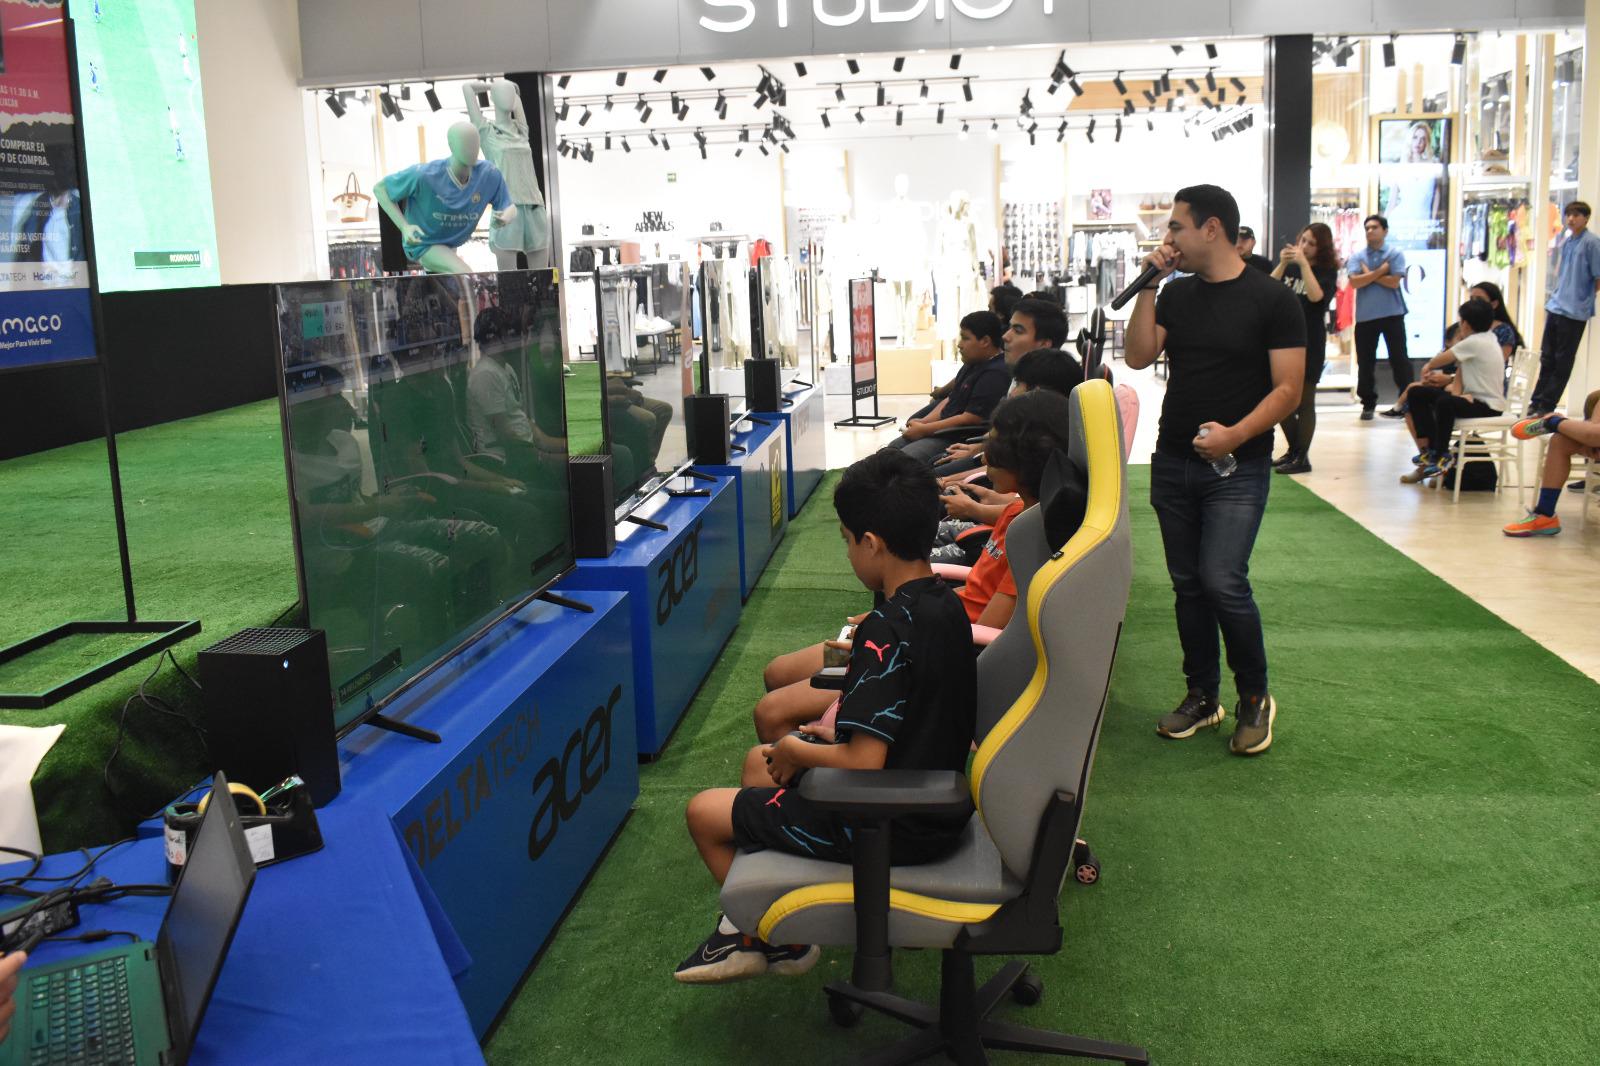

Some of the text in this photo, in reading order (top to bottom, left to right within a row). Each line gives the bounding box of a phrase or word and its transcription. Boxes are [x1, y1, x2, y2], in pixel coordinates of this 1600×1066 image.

[1, 139, 36, 151] COMPRAR
[7, 153, 17, 163] DE
[18, 154, 50, 166] COMPRA.
[432, 212, 480, 221] ETIHAD
[643, 211, 663, 223] NEW
[657, 517, 703, 626] acer
[528, 684, 621, 861] acer
[405, 702, 541, 869] DELTATECH
